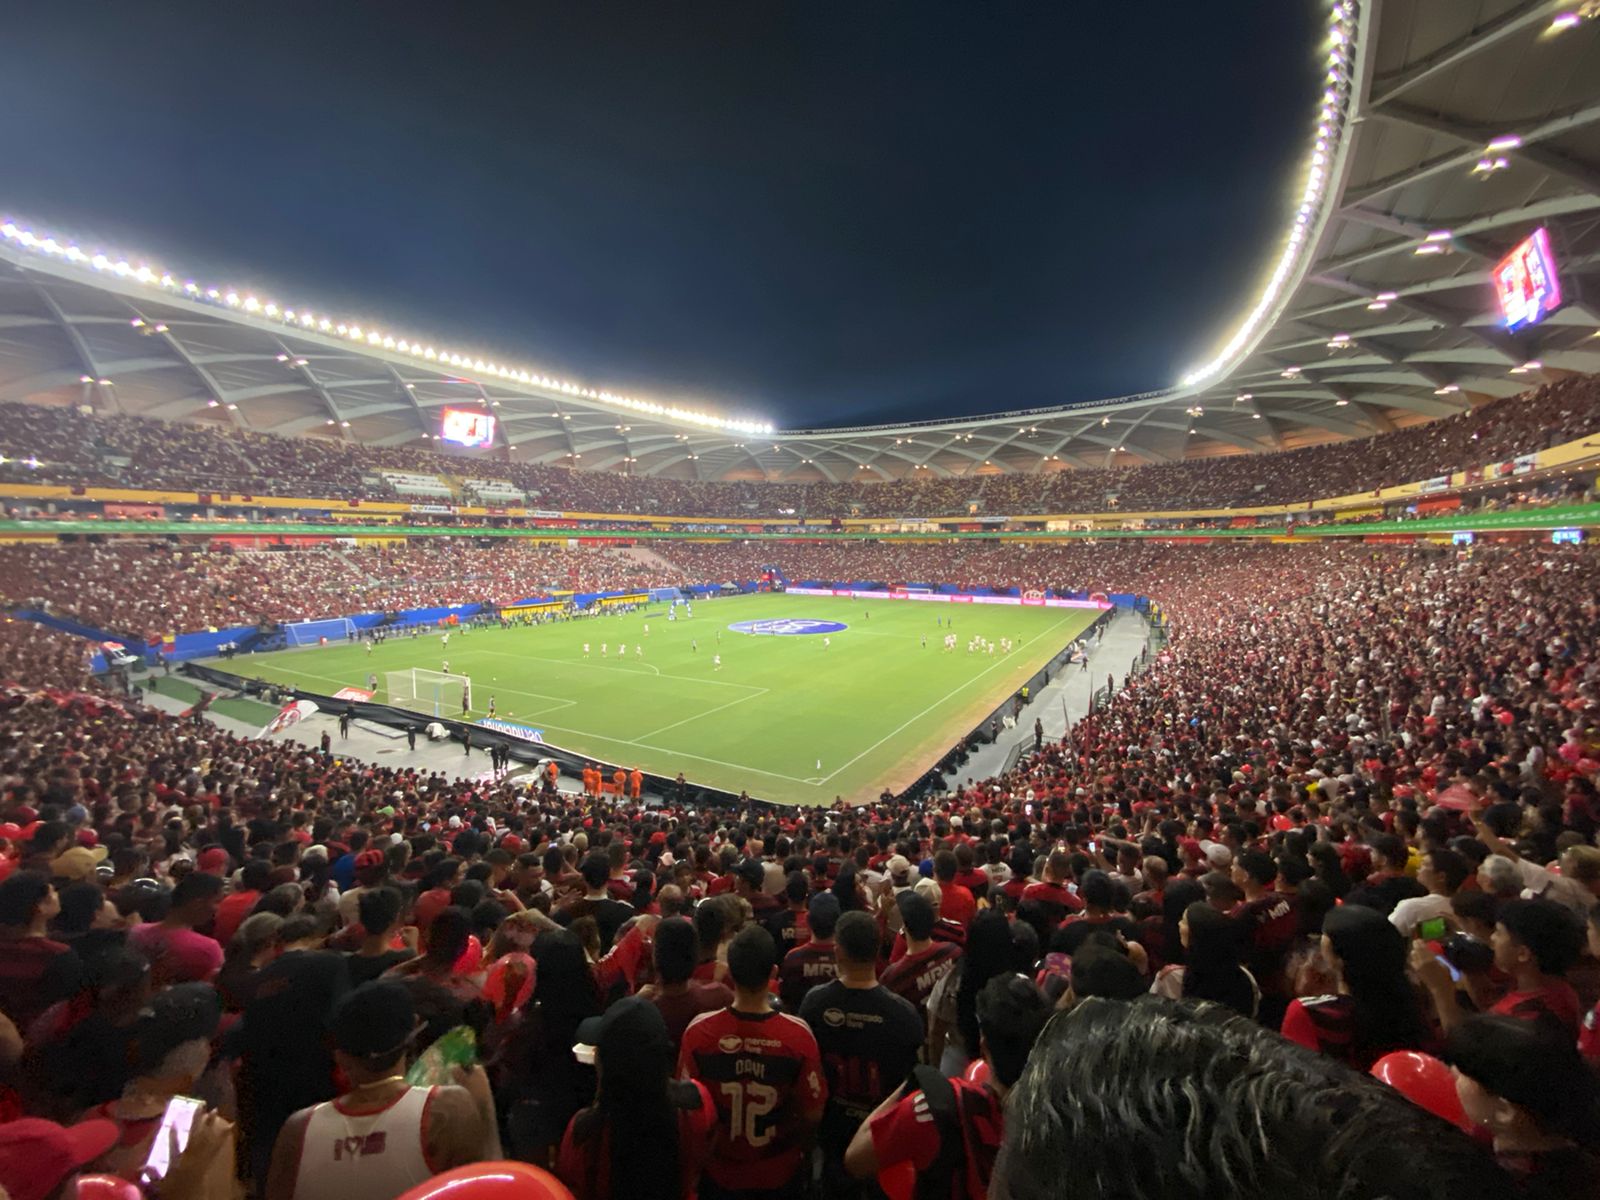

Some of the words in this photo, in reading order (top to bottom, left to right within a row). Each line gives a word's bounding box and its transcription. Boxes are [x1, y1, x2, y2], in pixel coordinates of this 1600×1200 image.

[744, 1037, 782, 1048] mercado
[735, 1059, 765, 1078] DAVI
[720, 1080, 778, 1147] 12
